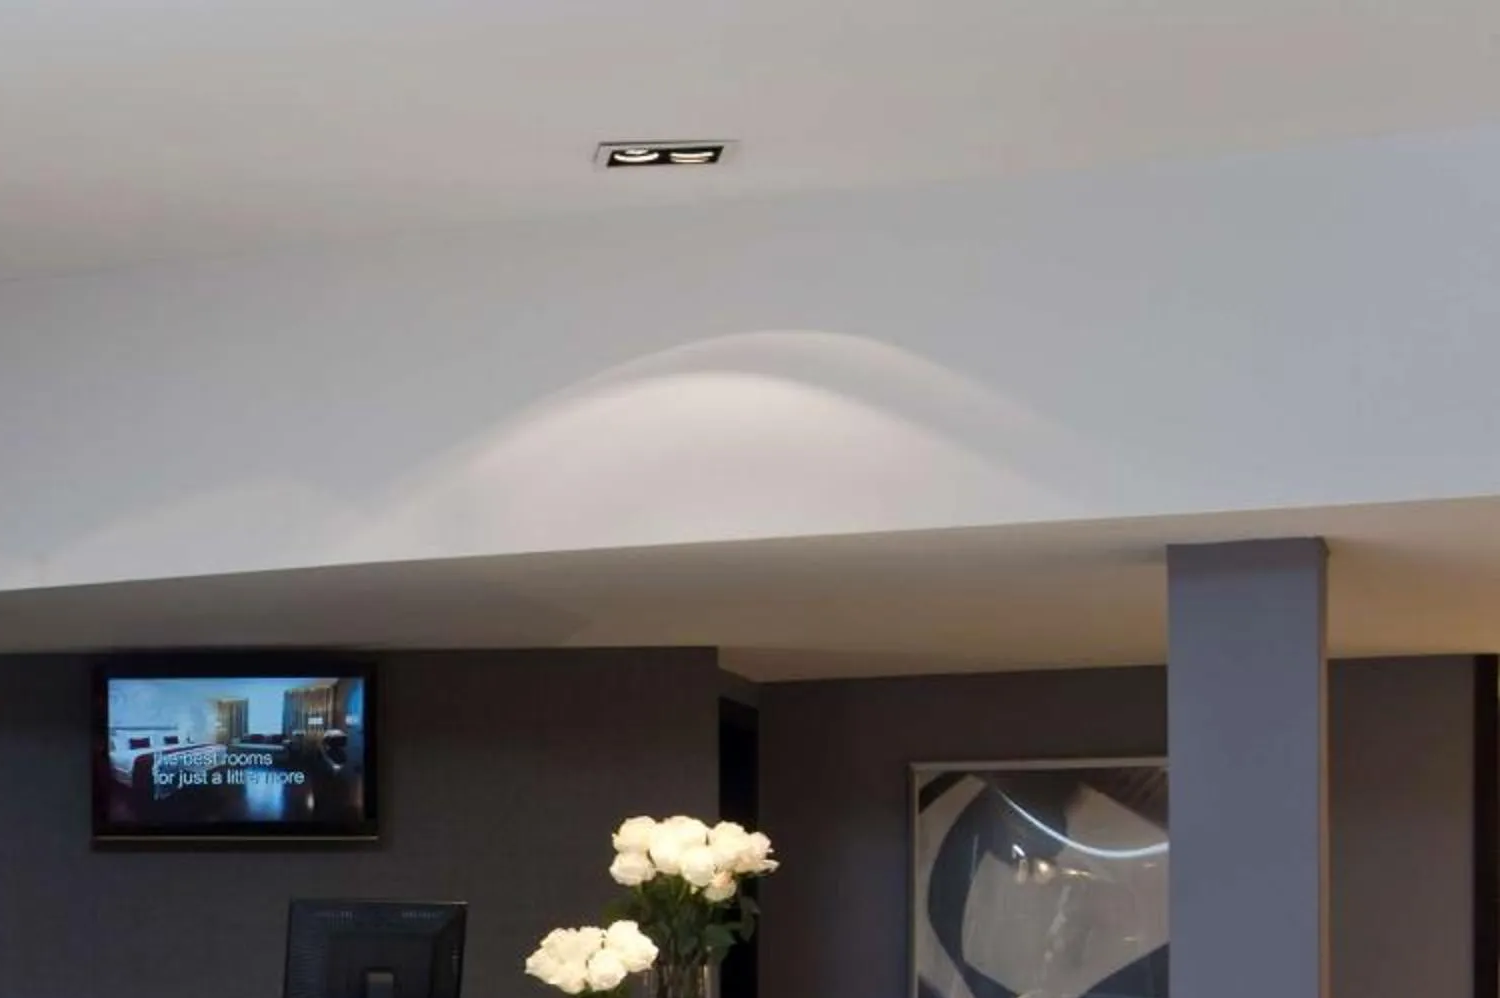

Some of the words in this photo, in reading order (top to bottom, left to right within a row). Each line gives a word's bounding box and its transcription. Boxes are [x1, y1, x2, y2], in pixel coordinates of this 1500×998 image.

[183, 749, 217, 765] best
[222, 752, 273, 766] rooms
[152, 768, 175, 785] for
[177, 769, 208, 789] just
[211, 772, 223, 785] a
[261, 772, 304, 785] more
